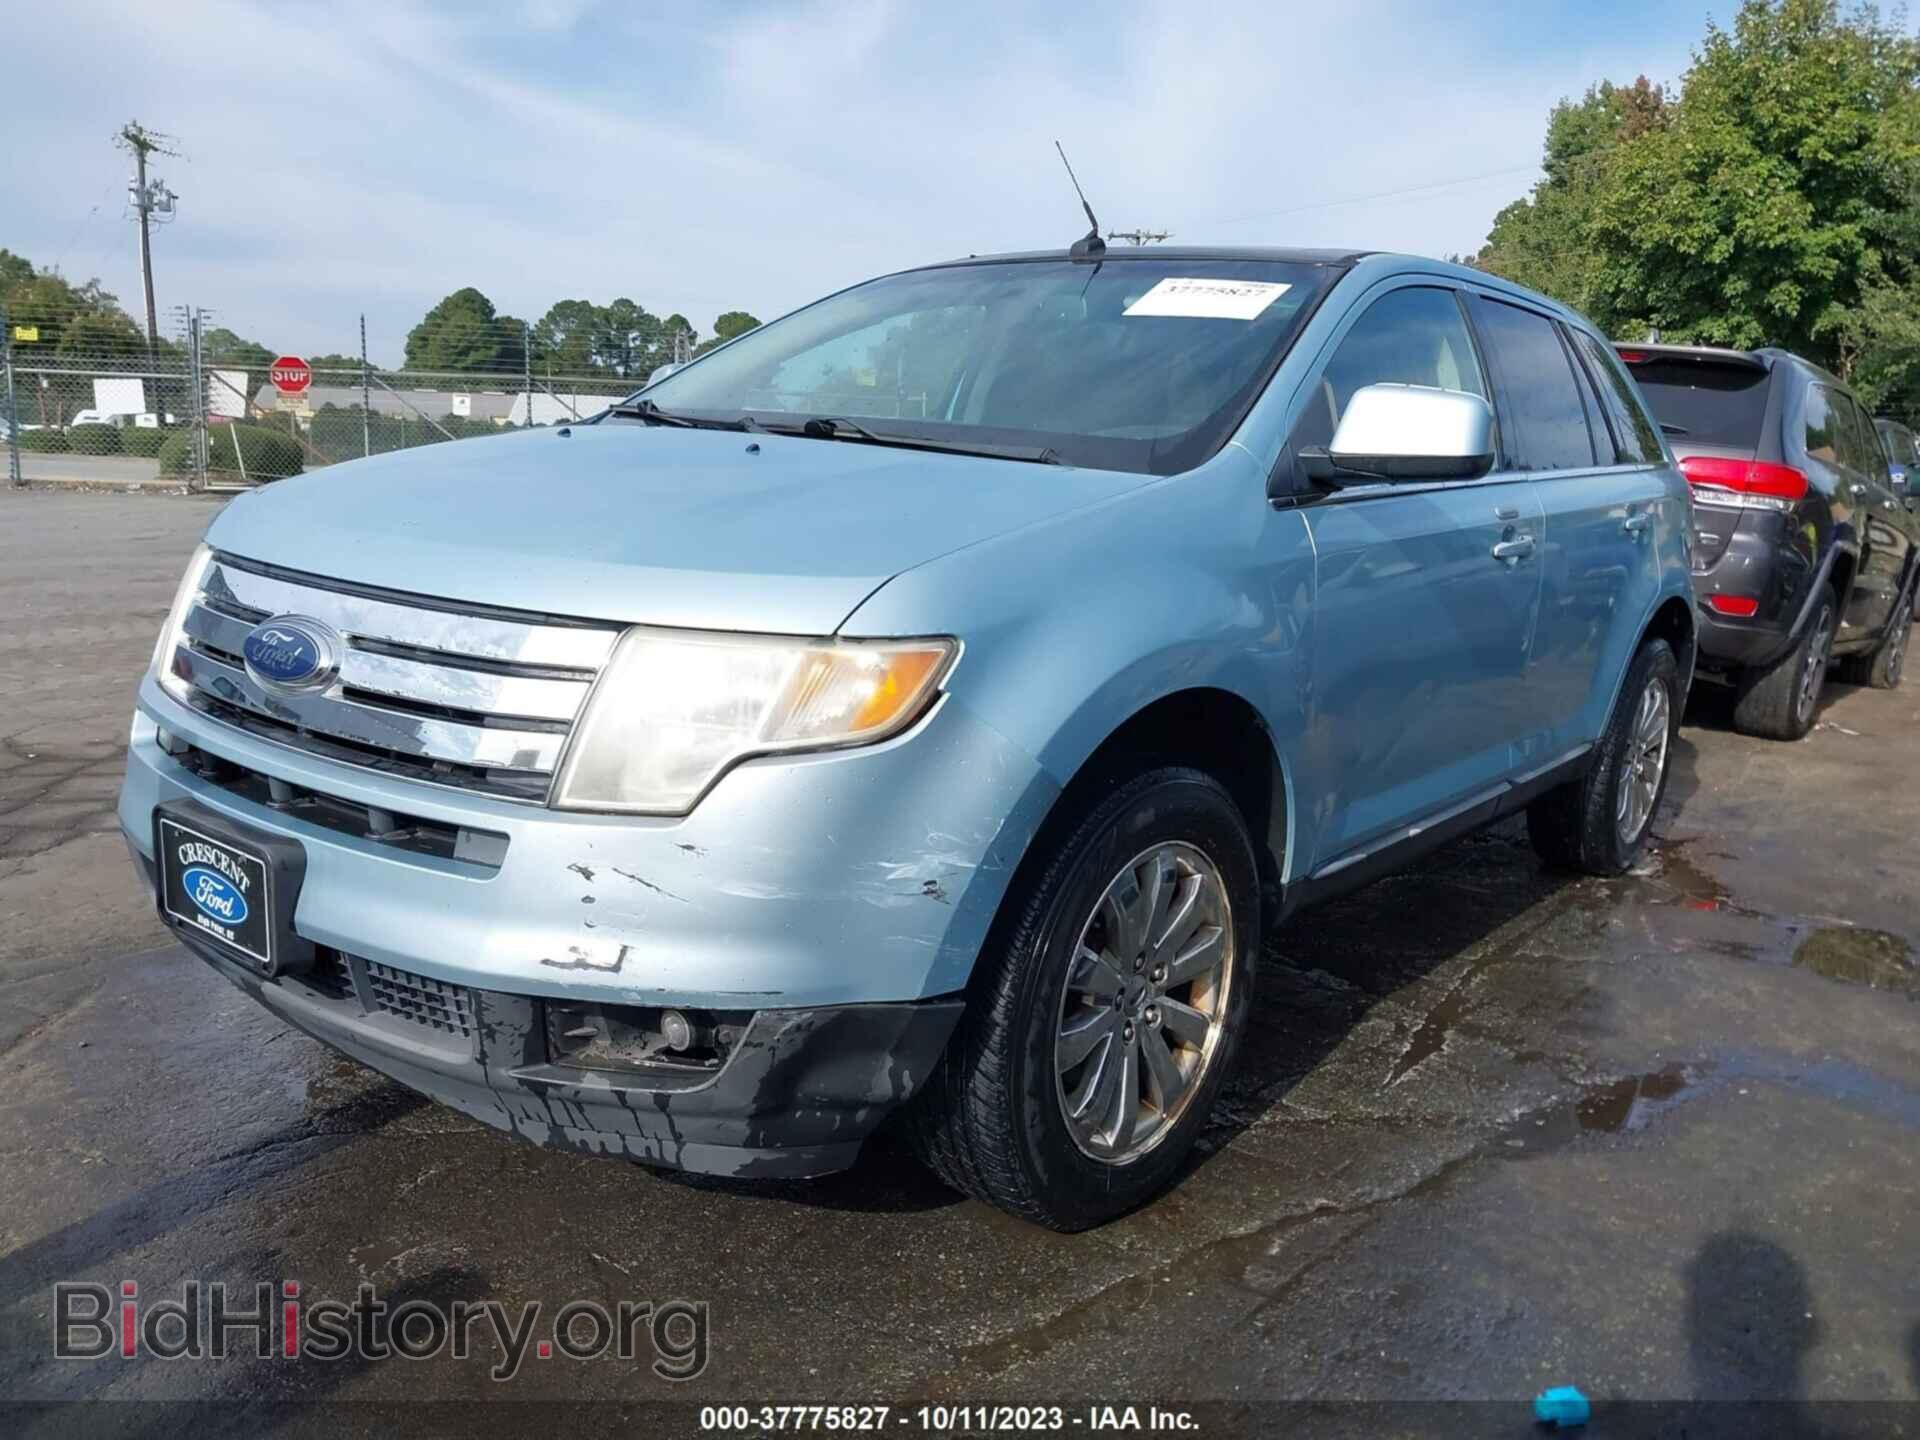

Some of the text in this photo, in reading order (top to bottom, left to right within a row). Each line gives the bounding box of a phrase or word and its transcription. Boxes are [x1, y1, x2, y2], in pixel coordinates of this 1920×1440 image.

[274, 369, 307, 382] STOP
[178, 842, 250, 893] CRESCENT
[196, 876, 235, 916] Ford
